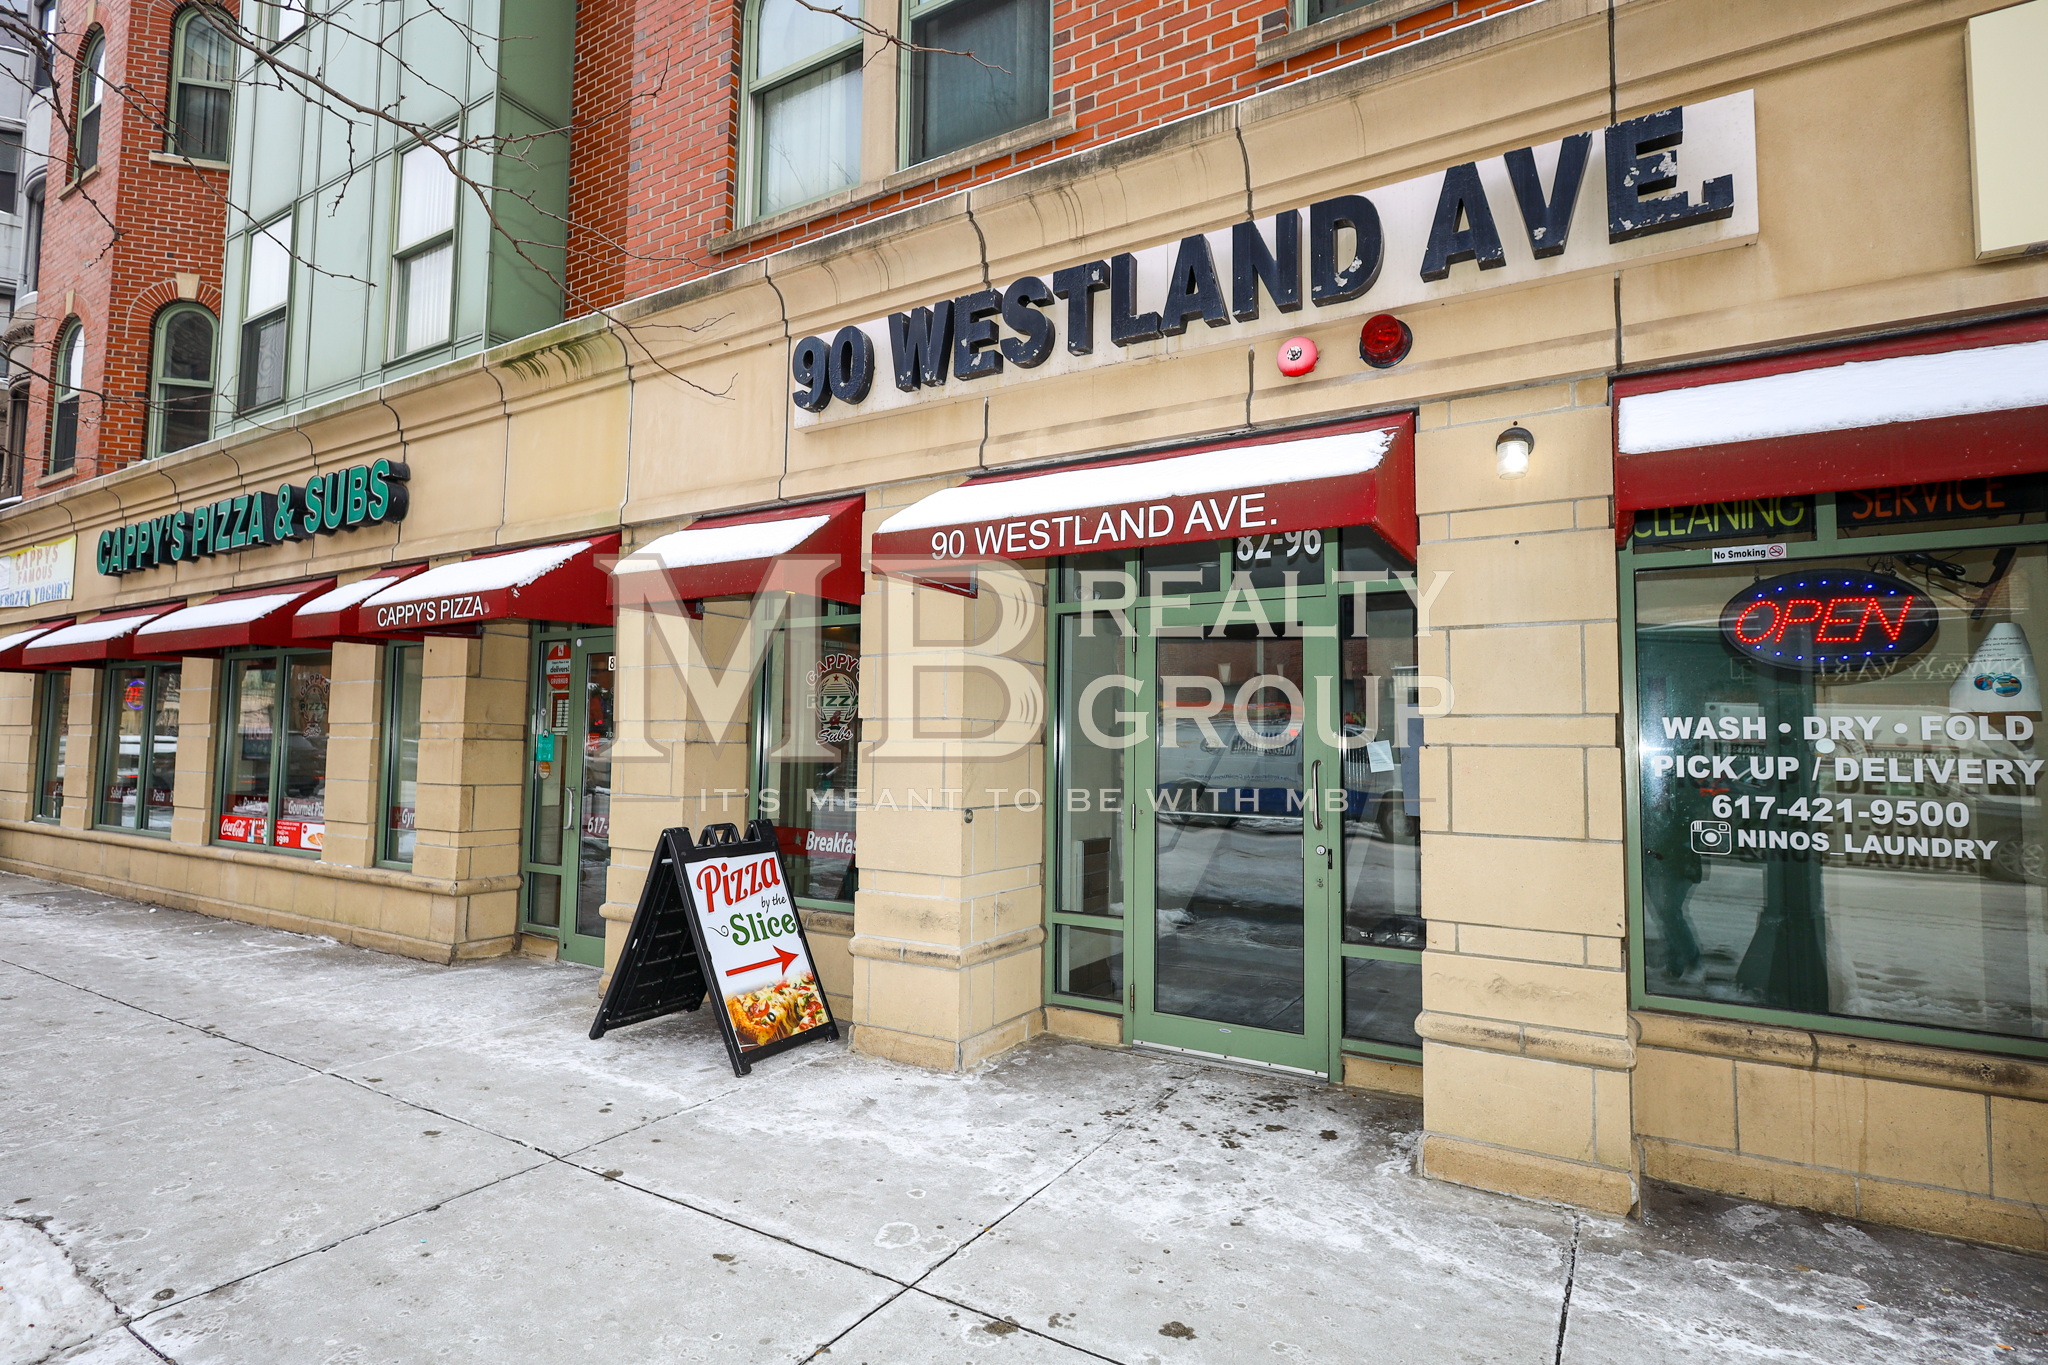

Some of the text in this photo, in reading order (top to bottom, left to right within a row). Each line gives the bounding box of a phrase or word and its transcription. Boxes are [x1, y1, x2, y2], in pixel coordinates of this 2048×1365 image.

[792, 106, 1734, 412] 90 WESTLAND AVE.
[1852, 477, 2006, 519] SERVICE
[97, 458, 391, 576] CAPPY'S PIZZA & SUBS
[930, 492, 1278, 561] 90 WESTLAND AVE.
[1634, 497, 1805, 538] LEANING
[1236, 529, 1322, 561] 82-96
[1713, 548, 1766, 560] No Smoking
[17, 564, 53, 585] FAMOUS
[34, 580, 70, 604] YOGURT
[377, 595, 484, 627] CAPPY'S PIZZA
[1735, 596, 1914, 644] OPEN
[125, 686, 145, 703] OPE
[300, 702, 327, 711] PIZZA
[816, 727, 853, 745] Subs
[1662, 715, 2034, 741] WASH DRY FOLD
[1654, 755, 2046, 786] PICK UP / DELIVERY
[153, 788, 165, 802] Pasta
[288, 800, 324, 817] Gourmet Piz
[401, 807, 415, 828] Gyr
[1712, 795, 1970, 828] 617-421-9500
[805, 830, 857, 855] Breakfas
[1738, 829, 1998, 861] NINOS_LAUNDRY
[696, 857, 781, 914] Pizza
[761, 893, 787, 914] by the
[729, 912, 797, 946] Slice
